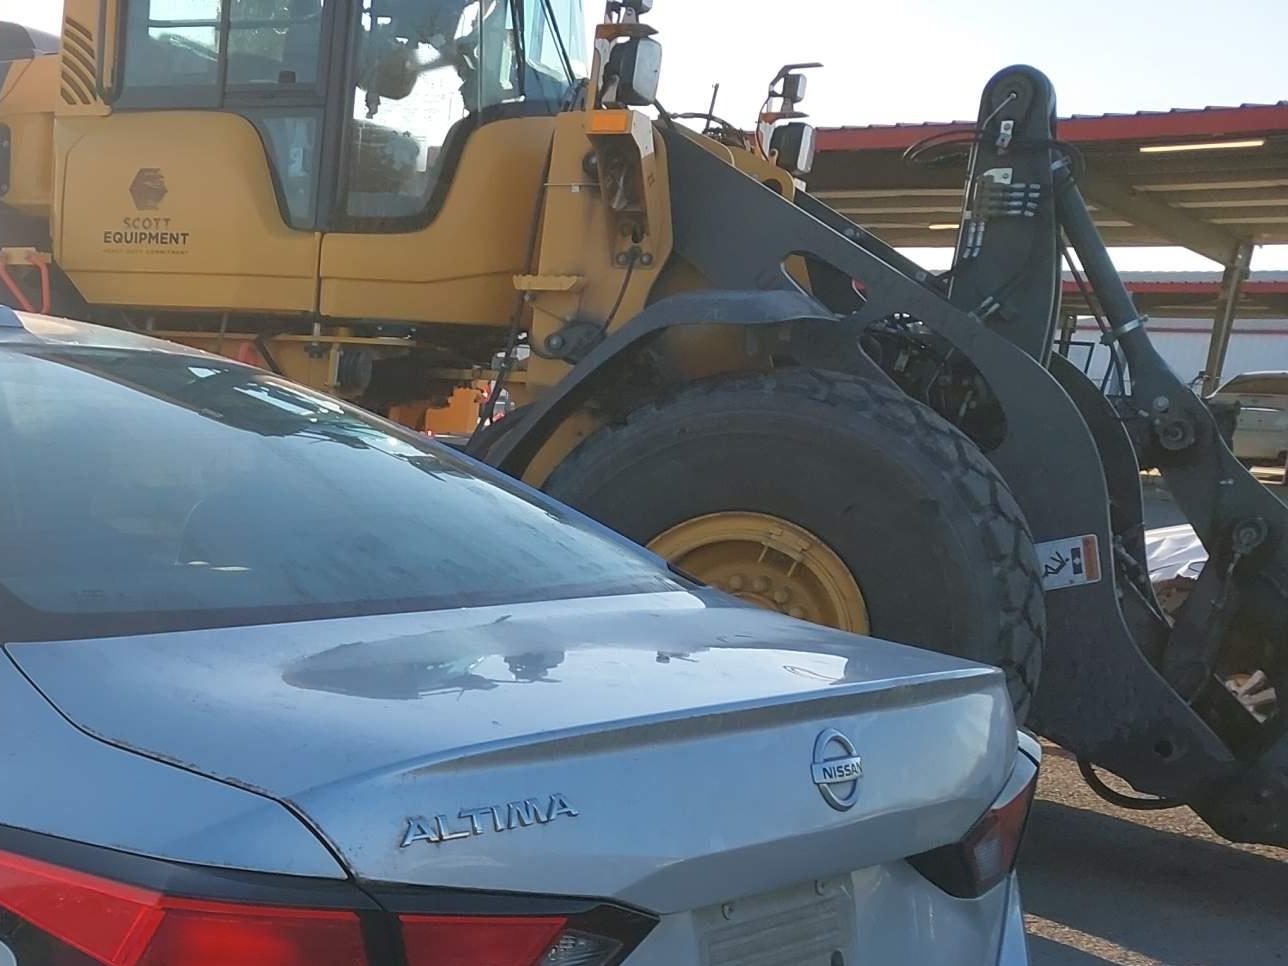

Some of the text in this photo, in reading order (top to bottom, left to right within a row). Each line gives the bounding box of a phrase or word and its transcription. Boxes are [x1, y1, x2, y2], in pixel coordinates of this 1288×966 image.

[122, 216, 172, 230] SCOTT
[103, 231, 190, 246] EQUIPMENT
[822, 760, 864, 780] NISSAN
[400, 792, 580, 847] ALTIMA
